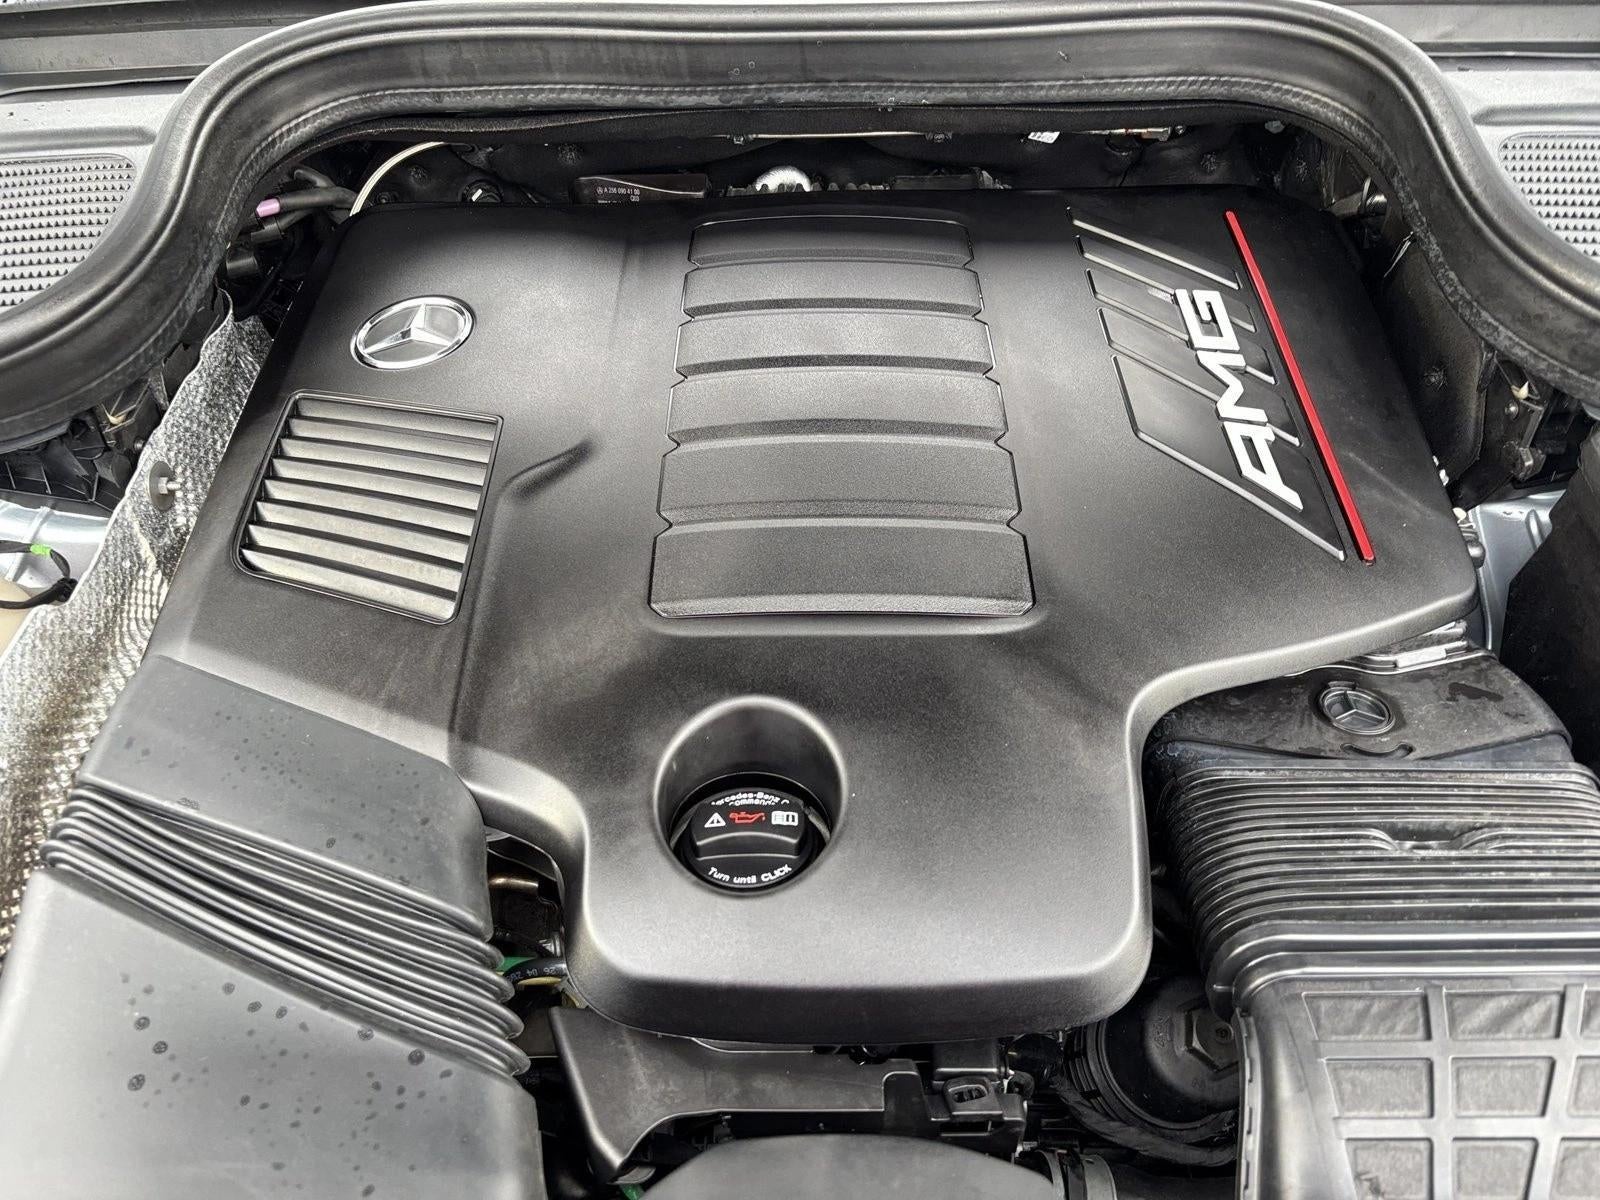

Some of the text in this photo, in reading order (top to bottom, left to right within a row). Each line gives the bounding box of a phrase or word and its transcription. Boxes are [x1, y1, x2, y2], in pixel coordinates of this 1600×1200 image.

[1175, 288, 1304, 513] AMG
[708, 863, 793, 884] Turn until CLICK
